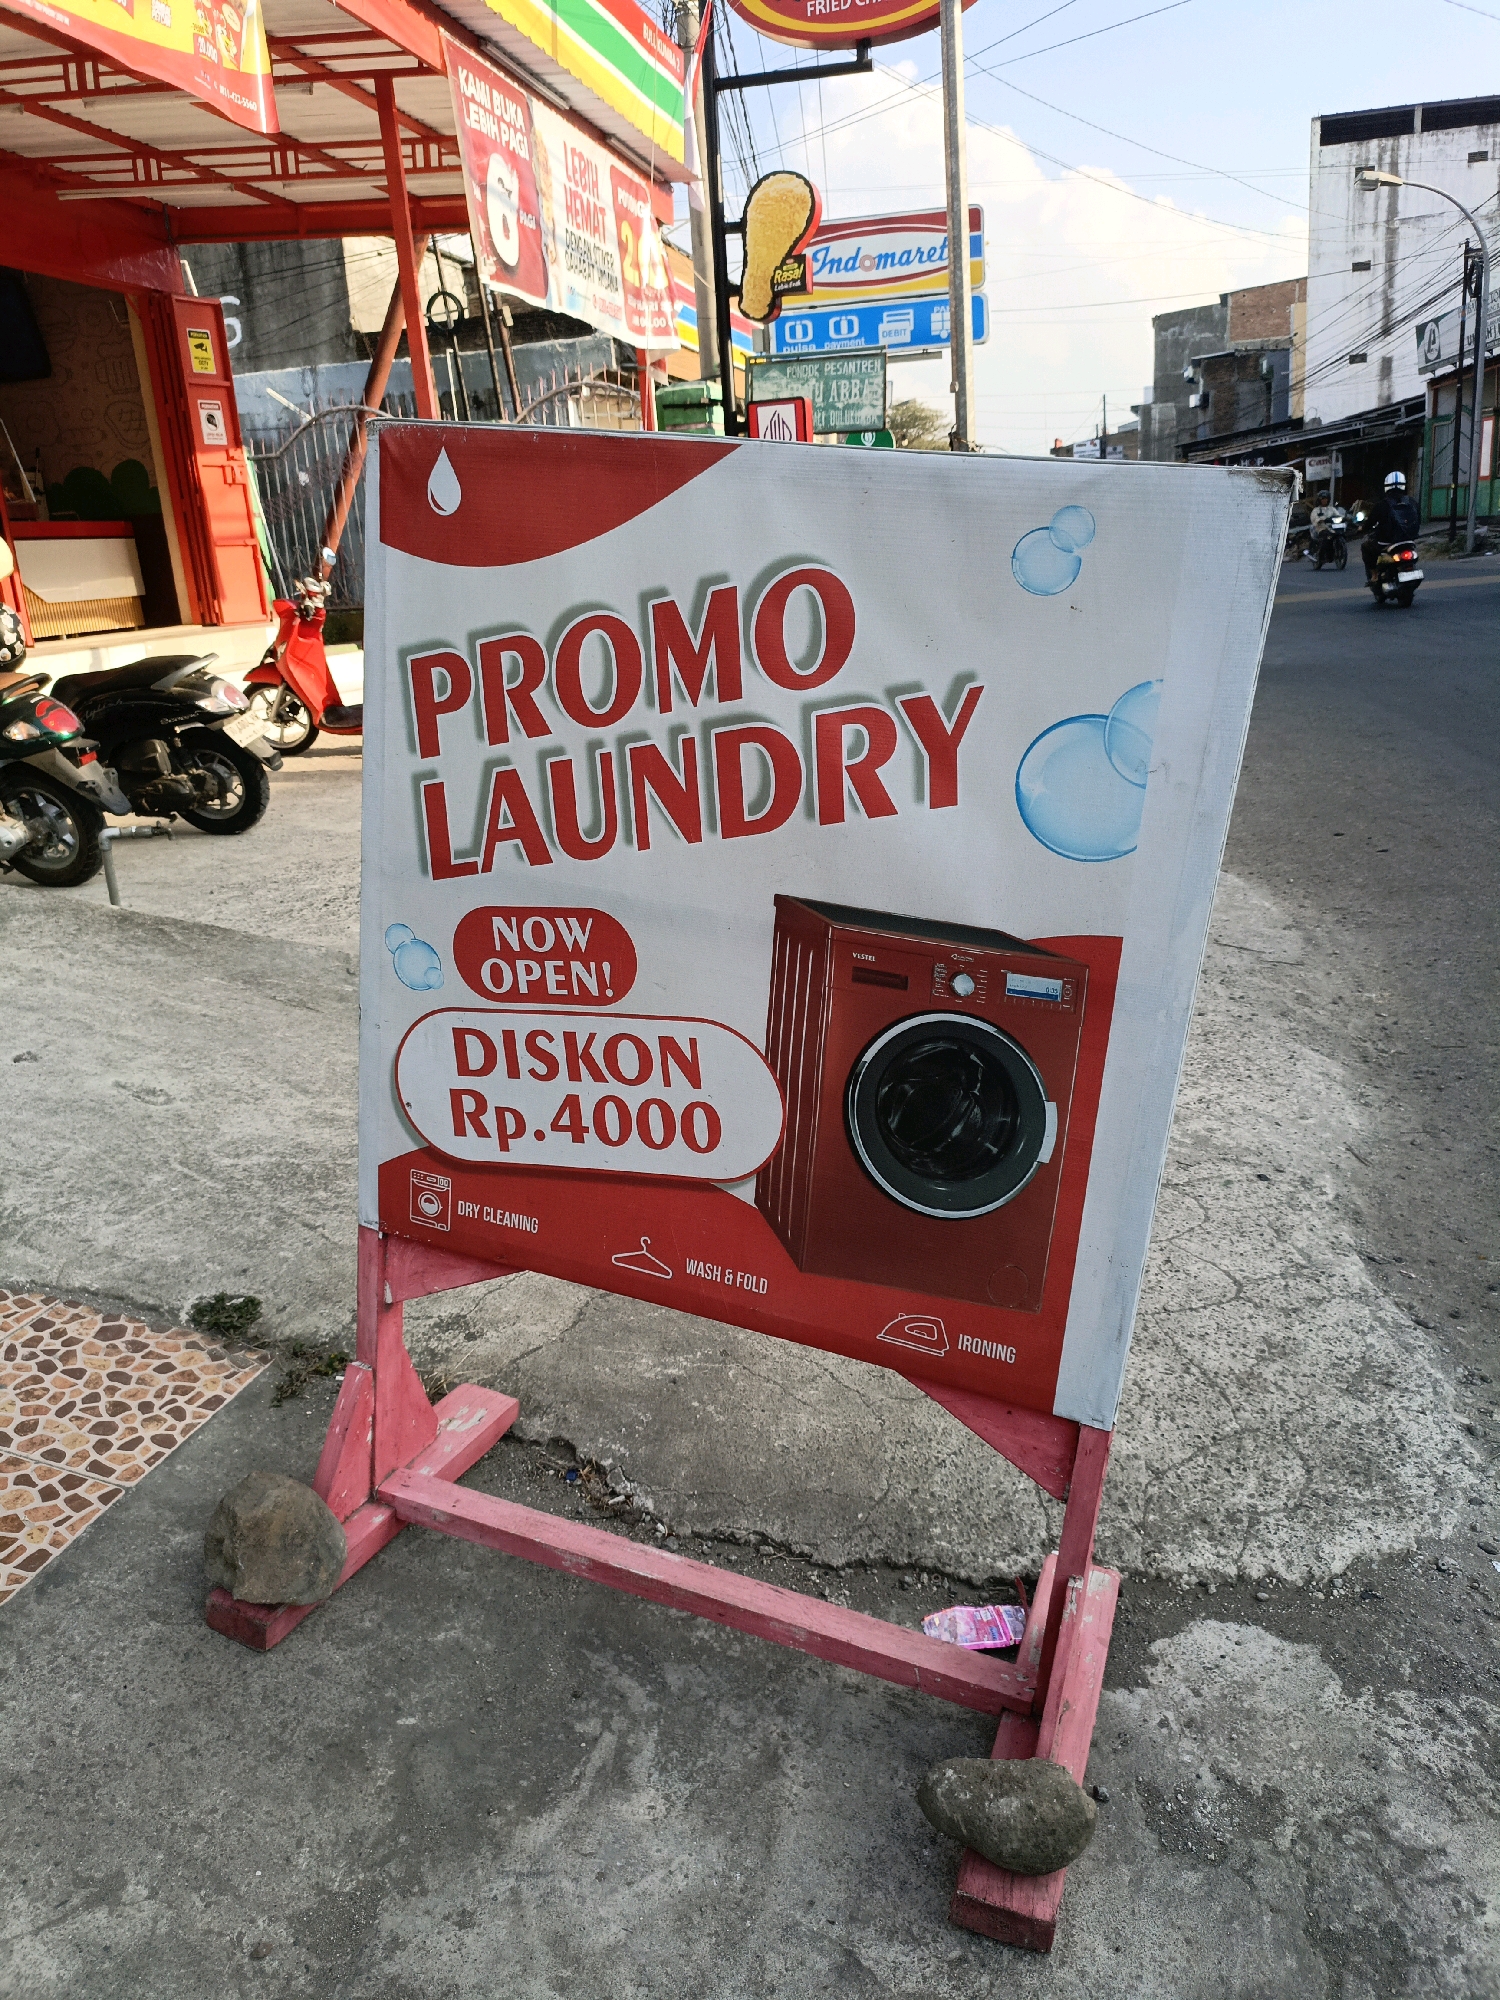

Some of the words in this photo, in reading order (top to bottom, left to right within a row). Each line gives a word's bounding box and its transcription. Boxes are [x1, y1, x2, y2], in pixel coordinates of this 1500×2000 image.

[807, 0, 851, 16] FRIED
[458, 66, 491, 109] KAMI
[492, 90, 526, 132] BUKA
[462, 97, 500, 143] LEBIH
[501, 124, 529, 160] PAGI
[564, 141, 599, 200] LEBIH
[486, 153, 519, 266] 6
[564, 183, 606, 245] HEMAT
[812, 236, 949, 277] Indomaret
[783, 343, 816, 353] pulsa
[824, 336, 865, 350] payment
[882, 328, 908, 338] DEBIT
[787, 364, 820, 379] PONDOK
[824, 359, 881, 376] PESANTREN
[408, 566, 856, 760] PROMO
[421, 684, 985, 881] LAUNDRY
[491, 916, 593, 953] NOW
[481, 959, 614, 997] OPEN!
[451, 1027, 702, 1089] DISKON
[449, 1088, 722, 1153] Rp.4000
[457, 1200, 481, 1219] DRY
[483, 1206, 539, 1234] CLEANING
[686, 1257, 721, 1283] WASH
[724, 1268, 734, 1285] &
[736, 1271, 768, 1295] FOLD
[957, 1333, 1017, 1364] IRONING
